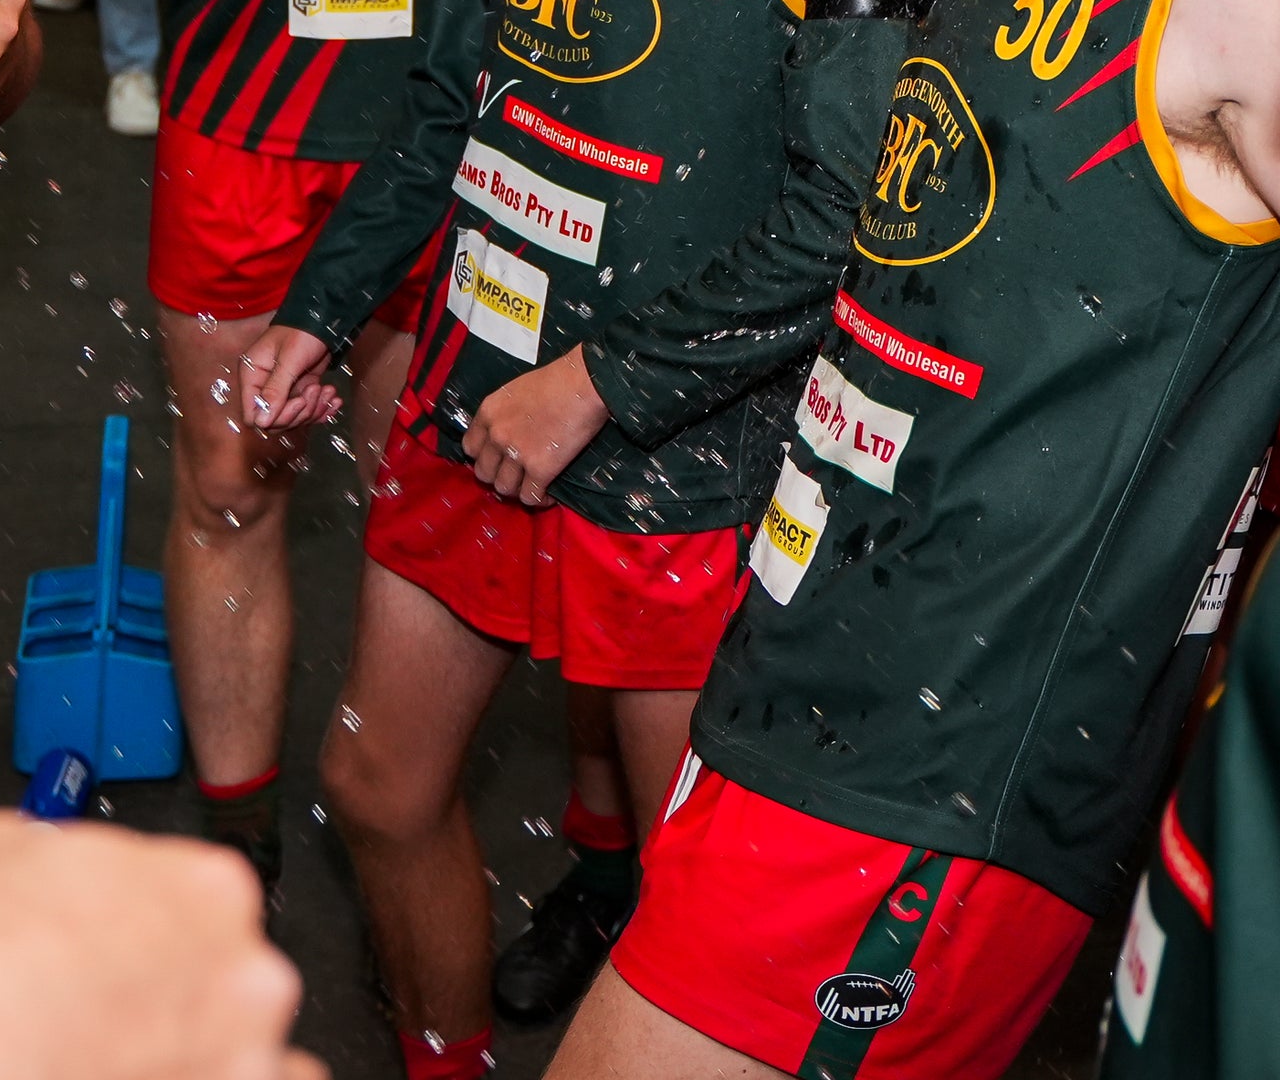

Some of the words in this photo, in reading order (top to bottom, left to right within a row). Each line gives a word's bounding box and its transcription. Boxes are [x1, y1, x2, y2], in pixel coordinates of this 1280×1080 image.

[503, 18, 556, 59] OTBALL
[557, 47, 590, 63] CLUB
[590, 7, 614, 24] 1925
[512, 104, 534, 127] CNW
[534, 117, 576, 150] Electrical
[579, 141, 649, 175] Wholesale
[893, 77, 965, 151] RIDGENORTH
[875, 113, 943, 213] BFC
[925, 174, 948, 193] 1925
[457, 161, 486, 189] EAMS
[490, 171, 521, 210] BROS
[525, 193, 553, 229] PTY
[559, 209, 593, 243] LTD
[882, 222, 917, 240] CLUB
[477, 274, 535, 318] IMPACT
[849, 309, 887, 349] Electrical
[886, 336, 966, 387] Wholesale
[807, 376, 832, 426] BROS
[854, 421, 895, 464] LTD
[777, 535, 804, 557] GROUP
[841, 1003, 900, 1022] NTFA
